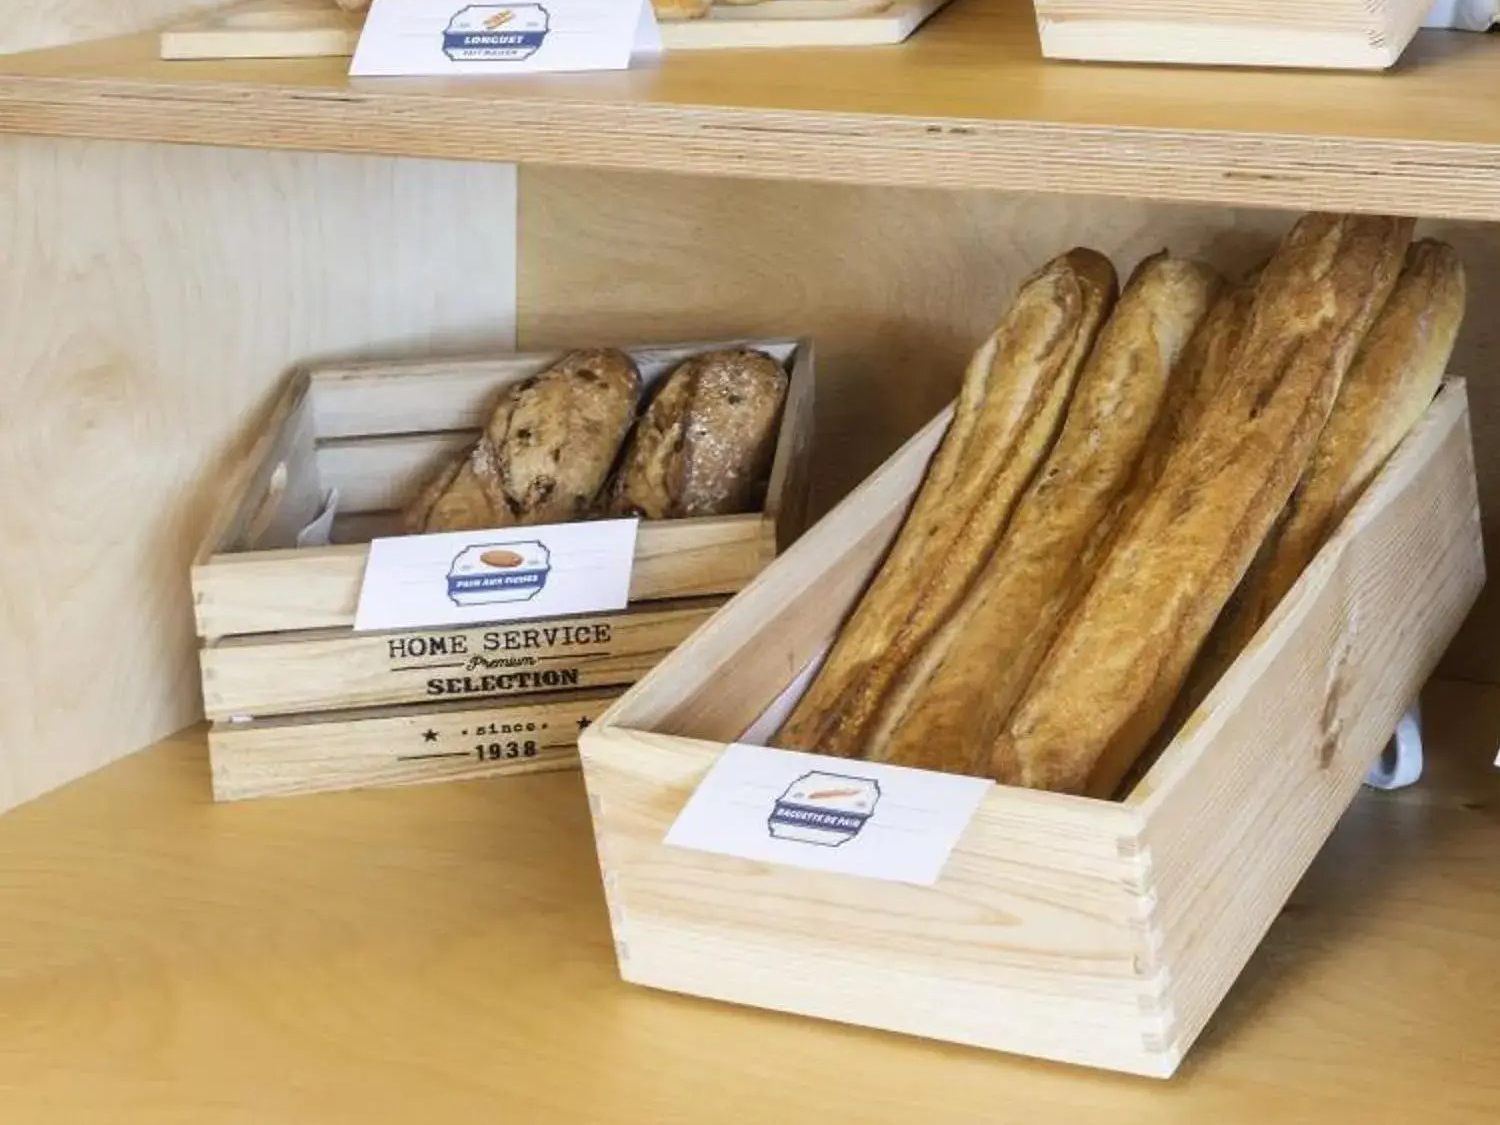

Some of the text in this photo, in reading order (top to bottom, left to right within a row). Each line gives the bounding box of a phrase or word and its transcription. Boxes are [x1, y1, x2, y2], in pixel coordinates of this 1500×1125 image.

[463, 35, 525, 45] LONGUET
[455, 577, 481, 588] PAIN
[388, 624, 611, 659] HOME SERVICE
[466, 654, 537, 671] Premium
[427, 668, 579, 695] SELECTION
[476, 723, 535, 736] since
[475, 739, 538, 762] 1938
[776, 807, 825, 822] BAGUETTE
